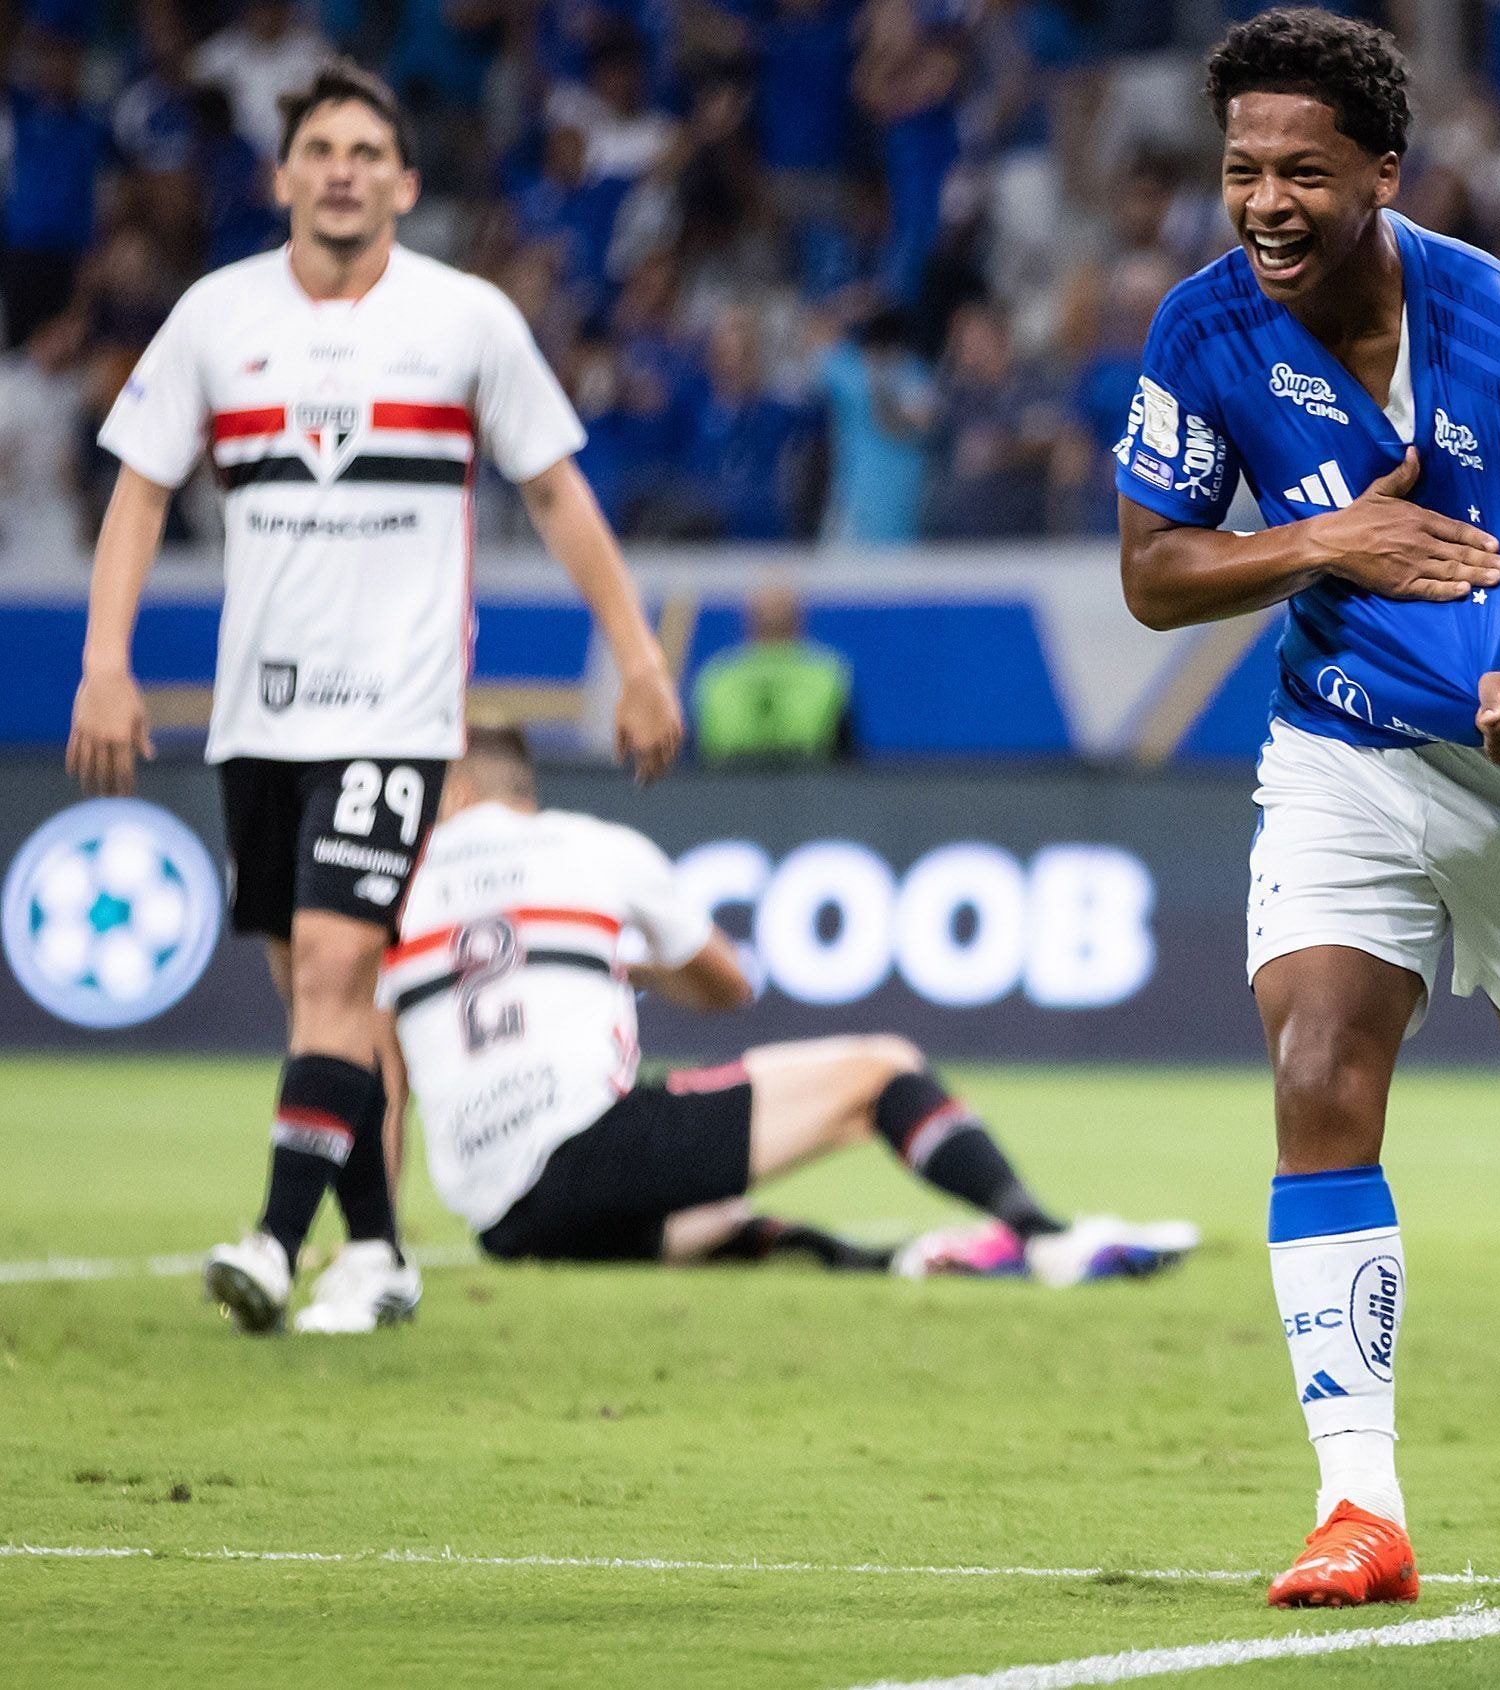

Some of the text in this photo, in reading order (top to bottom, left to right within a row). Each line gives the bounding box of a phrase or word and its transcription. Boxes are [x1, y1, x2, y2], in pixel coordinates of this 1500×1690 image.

[1269, 362, 1336, 405] Super
[1306, 402, 1349, 425] CIMED
[333, 760, 425, 847] 29
[453, 917, 526, 1055] 2
[1368, 1264, 1398, 1368] Kodilar
